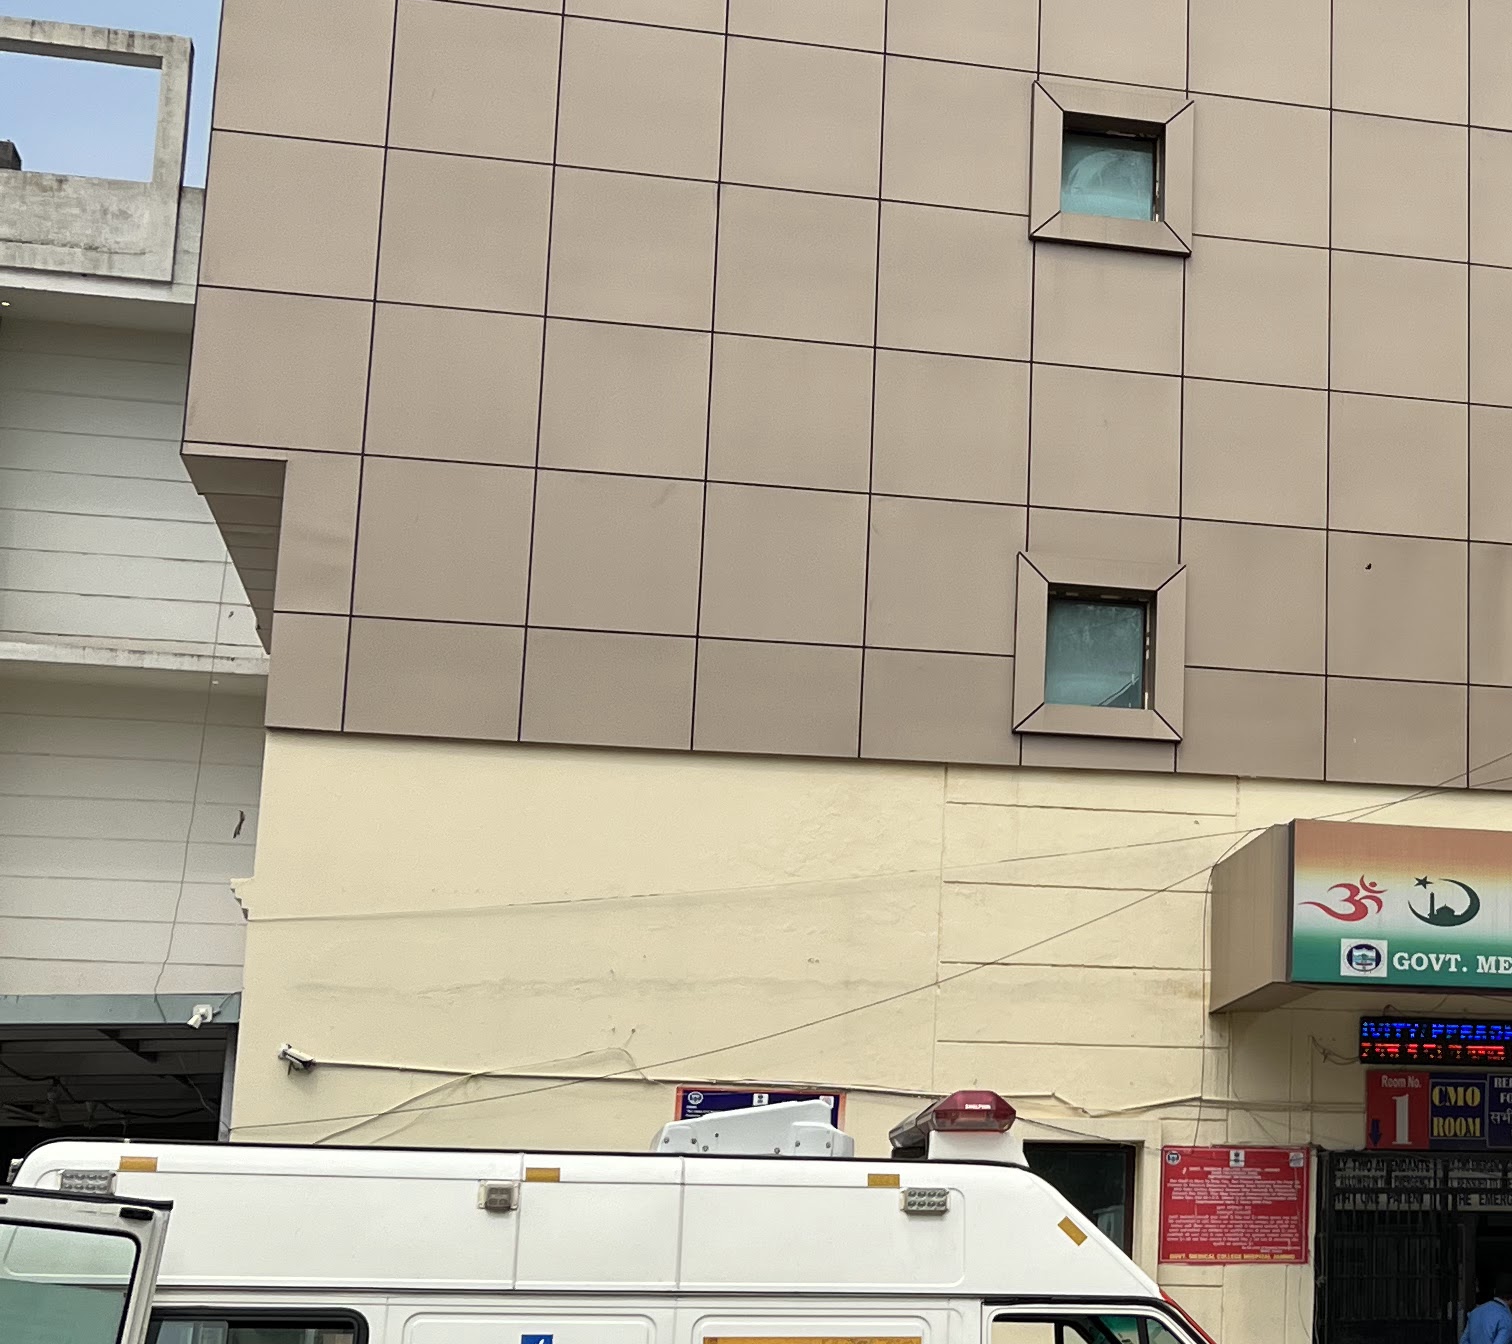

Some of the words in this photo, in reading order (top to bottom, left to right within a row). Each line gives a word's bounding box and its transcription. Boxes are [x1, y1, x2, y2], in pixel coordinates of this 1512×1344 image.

[1392, 952, 1468, 973] GOVT.
[1381, 1075, 1407, 1088] Room
[1407, 1075, 1422, 1088] No.
[1431, 1085, 1481, 1107] CMO
[1392, 1093, 1412, 1145] 1
[1432, 1116, 1481, 1137] ROOM
